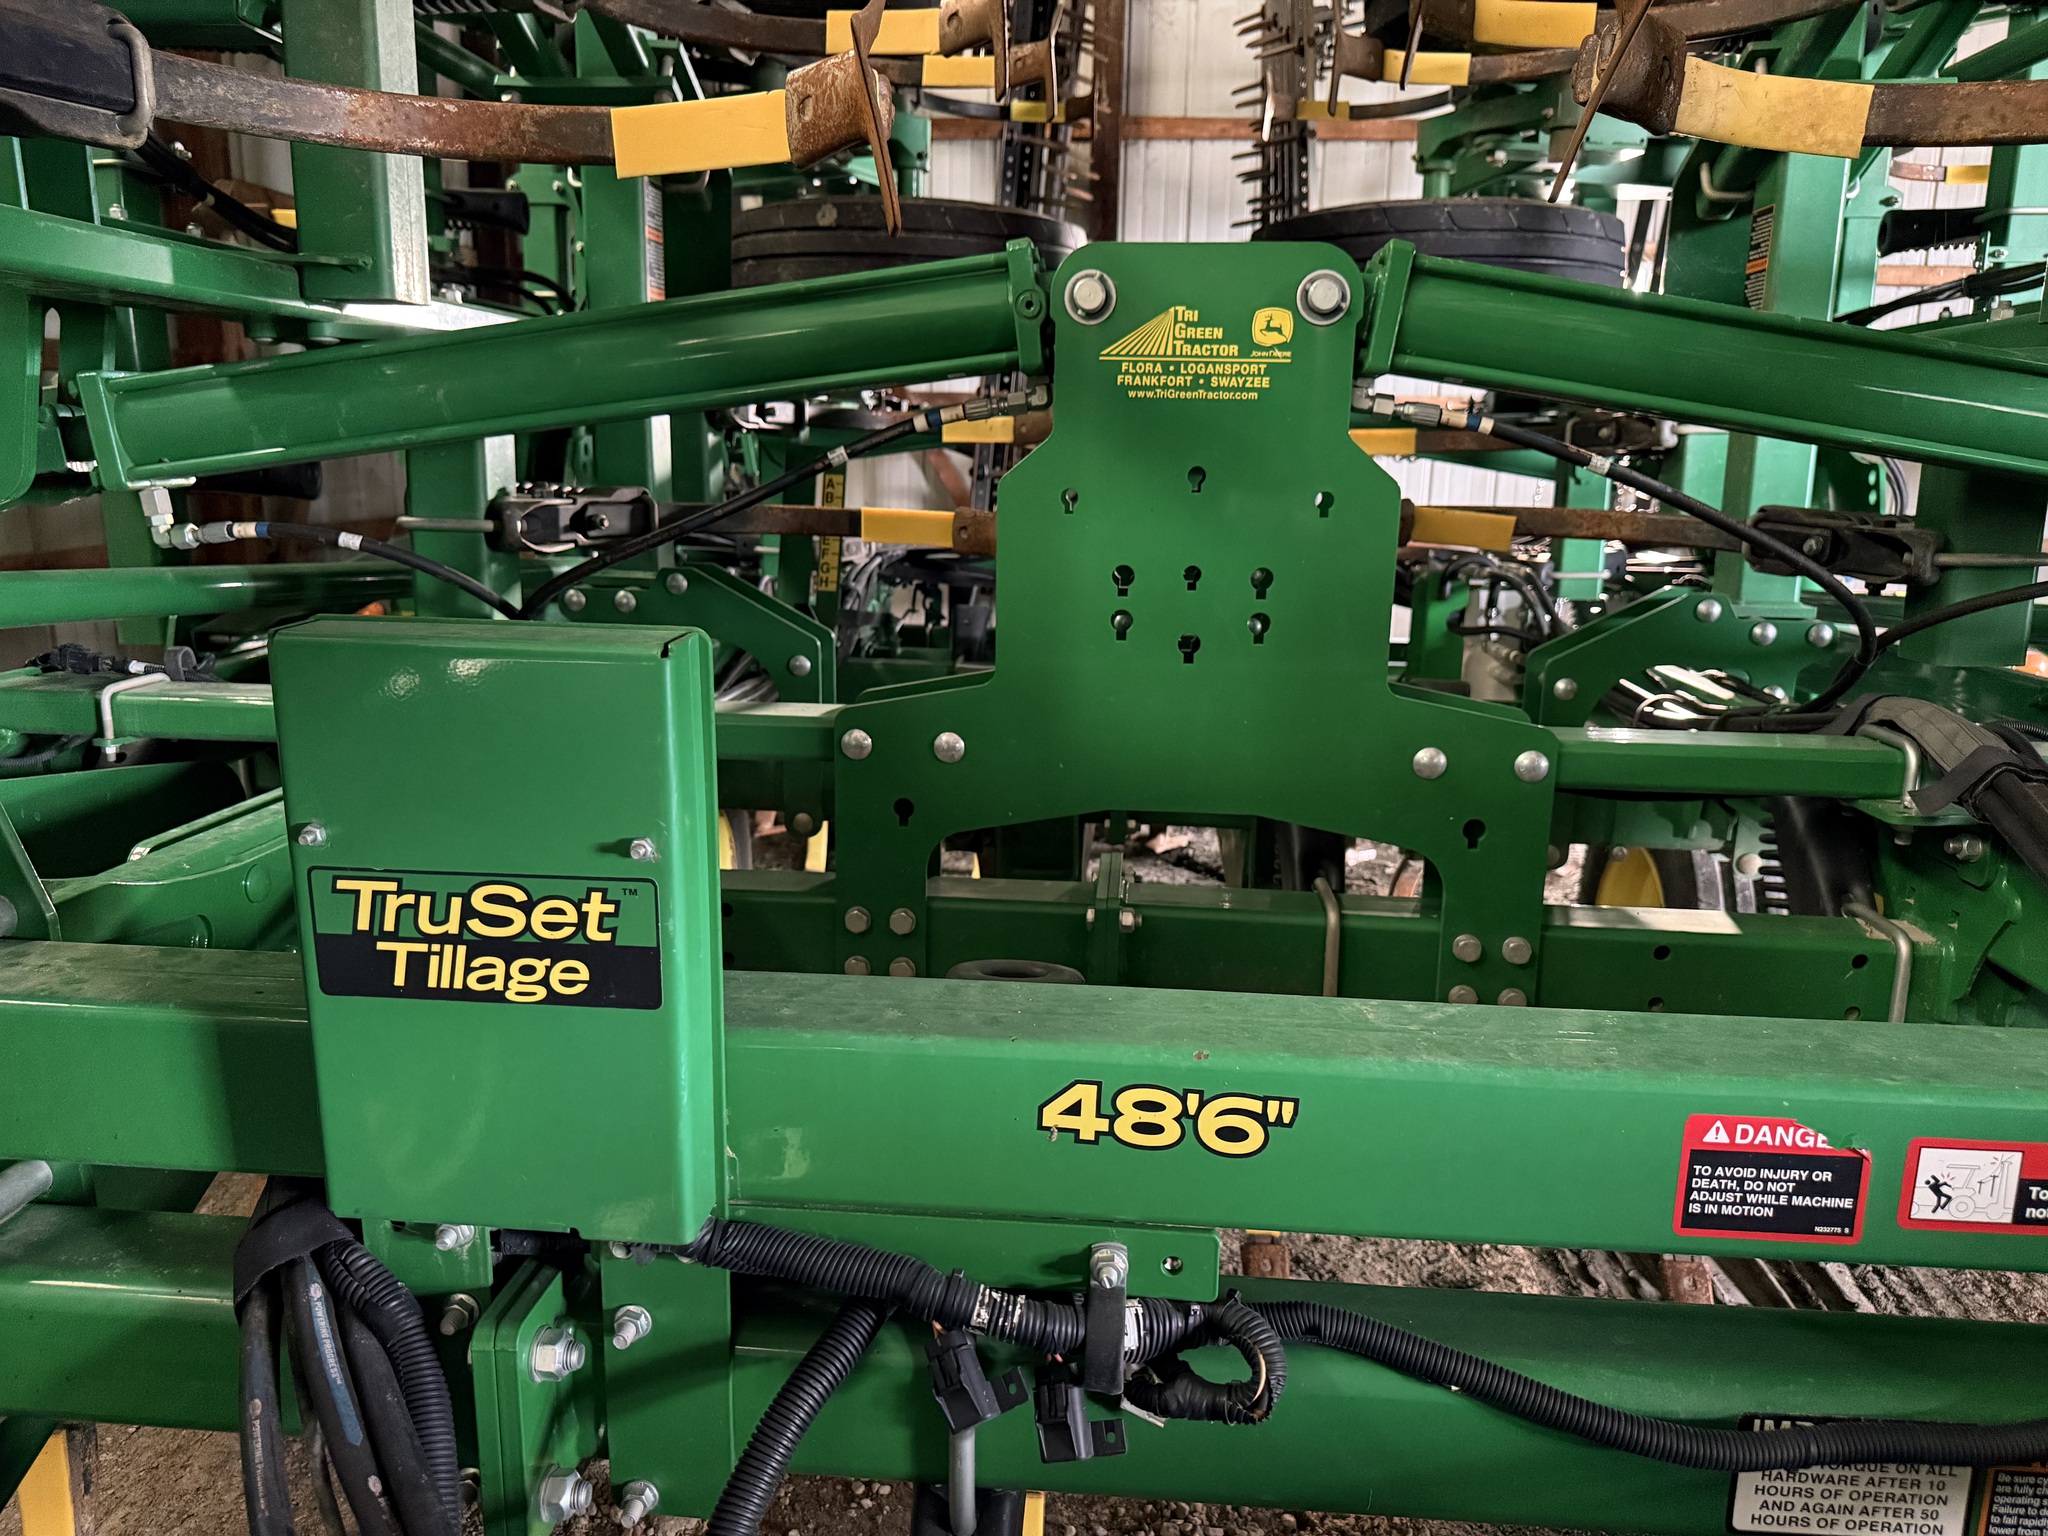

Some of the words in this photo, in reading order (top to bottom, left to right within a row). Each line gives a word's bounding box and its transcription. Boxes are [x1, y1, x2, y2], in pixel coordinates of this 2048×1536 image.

[1121, 362, 1162, 373] FLORA
[1180, 363, 1267, 375] LOGANSPORT
[1117, 375, 1193, 386] FRANKFORT
[1210, 377, 1270, 388] SWAYZEE
[1128, 389, 1258, 400] www.TriGreenTractor.com
[336, 879, 616, 941] TruSet
[376, 941, 590, 1003] Tillage
[1735, 1124, 1833, 1148] DANGE
[1693, 1165, 1711, 1176] TO
[1715, 1167, 1756, 1178] AVOID
[1760, 1168, 1808, 1180] INJURY
[1812, 1171, 1832, 1182] OR
[1692, 1178, 1740, 1191] DEATH,
[1744, 1181, 1763, 1191] DO
[1767, 1182, 1796, 1192] NOT
[1690, 1191, 1743, 1202] ADJUST
[1747, 1193, 1788, 1205] WHILE
[1791, 1196, 1853, 1208] MACHINE
[2029, 1186, 2048, 1201] To
[1689, 1203, 1701, 1213] IS
[1705, 1204, 1718, 1214] IN
[1721, 1205, 1773, 1217] MOTION
[2025, 1208, 2048, 1219] no
[315, 1301, 329, 1340] POWERING
[1896, 1464, 1919, 1476] ON
[1925, 1465, 1958, 1477] ALL
[1761, 1470, 1859, 1486] HARDWARE
[1866, 1477, 1921, 1489] AFTER
[1928, 1480, 1946, 1491] 10
[2013, 1475, 2036, 1483] sure
[1754, 1485, 1814, 1498] HOURS
[1820, 1489, 1843, 1500] OF
[1849, 1490, 1948, 1505] OPERATION
[2014, 1484, 2034, 1496] fully
[1994, 1495, 2040, 1507] operating
[1759, 1500, 1795, 1512] AND
[1800, 1502, 1854, 1515] AGAIN
[1859, 1506, 1915, 1519] AFTER
[1920, 1509, 1939, 1520] 50
[1992, 1504, 2026, 1514] Failure
[2028, 1507, 2037, 1515] to
[1751, 1514, 1810, 1528] HOURS
[1816, 1518, 1840, 1529] OF
[1845, 1519, 1944, 1535] OPERATION
[1991, 1515, 2000, 1523] to
[1988, 1525, 2016, 1534] lower
[2018, 1527, 2040, 1536] from
